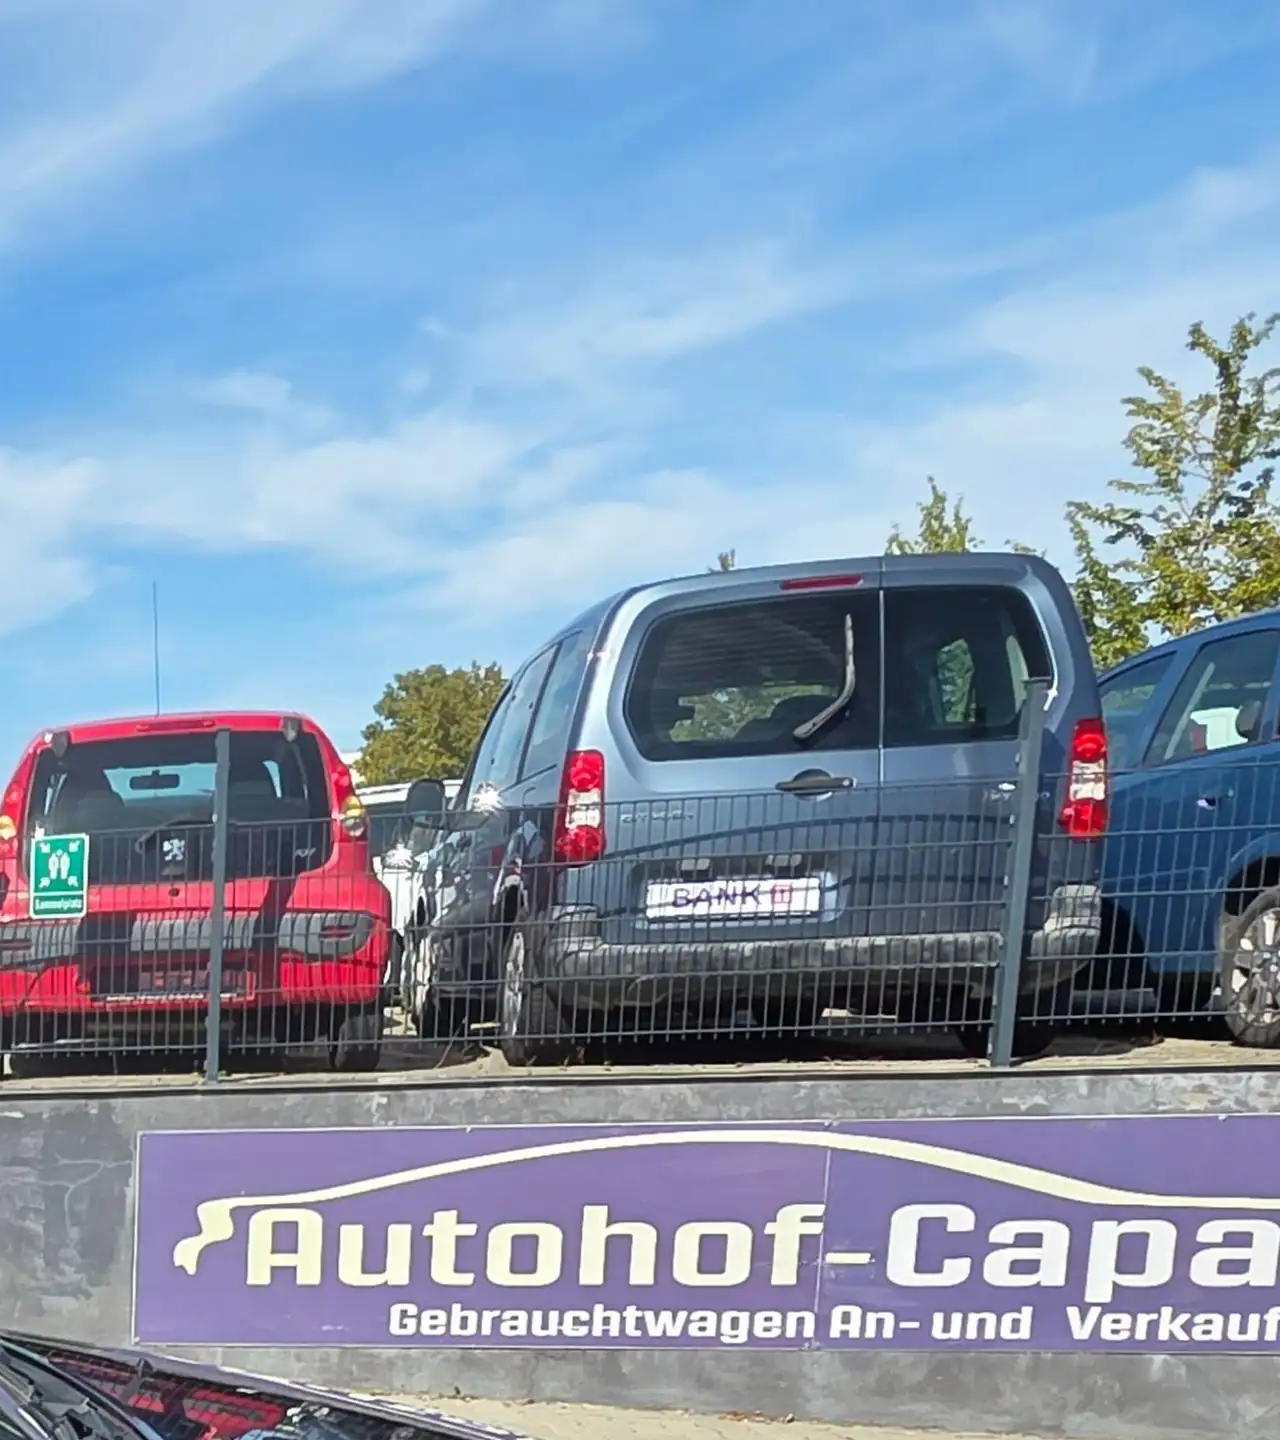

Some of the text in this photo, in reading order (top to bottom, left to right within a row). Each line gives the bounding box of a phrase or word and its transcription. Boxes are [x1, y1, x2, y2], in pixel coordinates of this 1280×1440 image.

[672, 883, 762, 908] BANK
[246, 1203, 1280, 1303] Autohof-Capa
[389, 1303, 1280, 1344] Gebrauchtwagen An- und Verkauf
